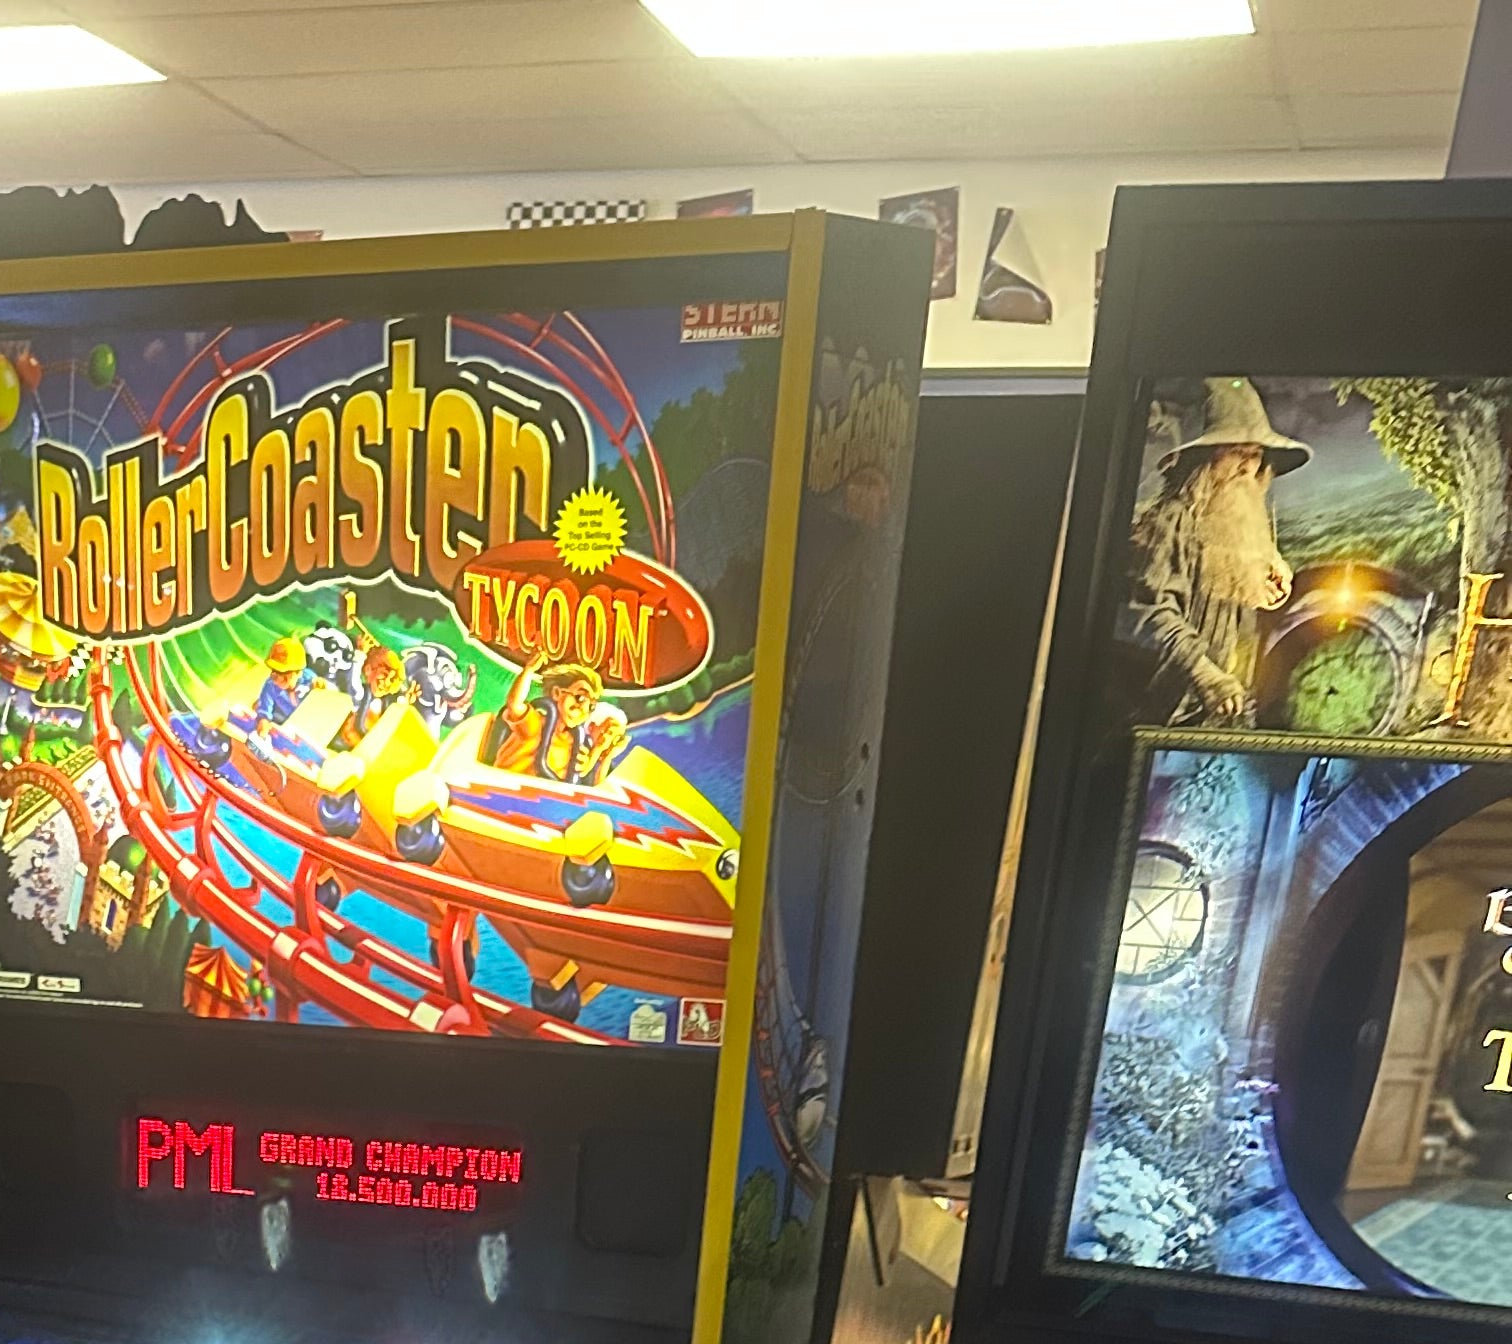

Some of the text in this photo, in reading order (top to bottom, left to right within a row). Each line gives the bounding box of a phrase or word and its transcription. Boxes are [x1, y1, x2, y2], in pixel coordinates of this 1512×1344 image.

[36, 338, 554, 637] RollerCoaster
[578, 507, 604, 517] Based
[567, 530, 612, 541] Top Selling
[591, 543, 614, 552] Game
[462, 570, 656, 688] TYCOON
[137, 1117, 522, 1197] PML GRAND CHAMPION
